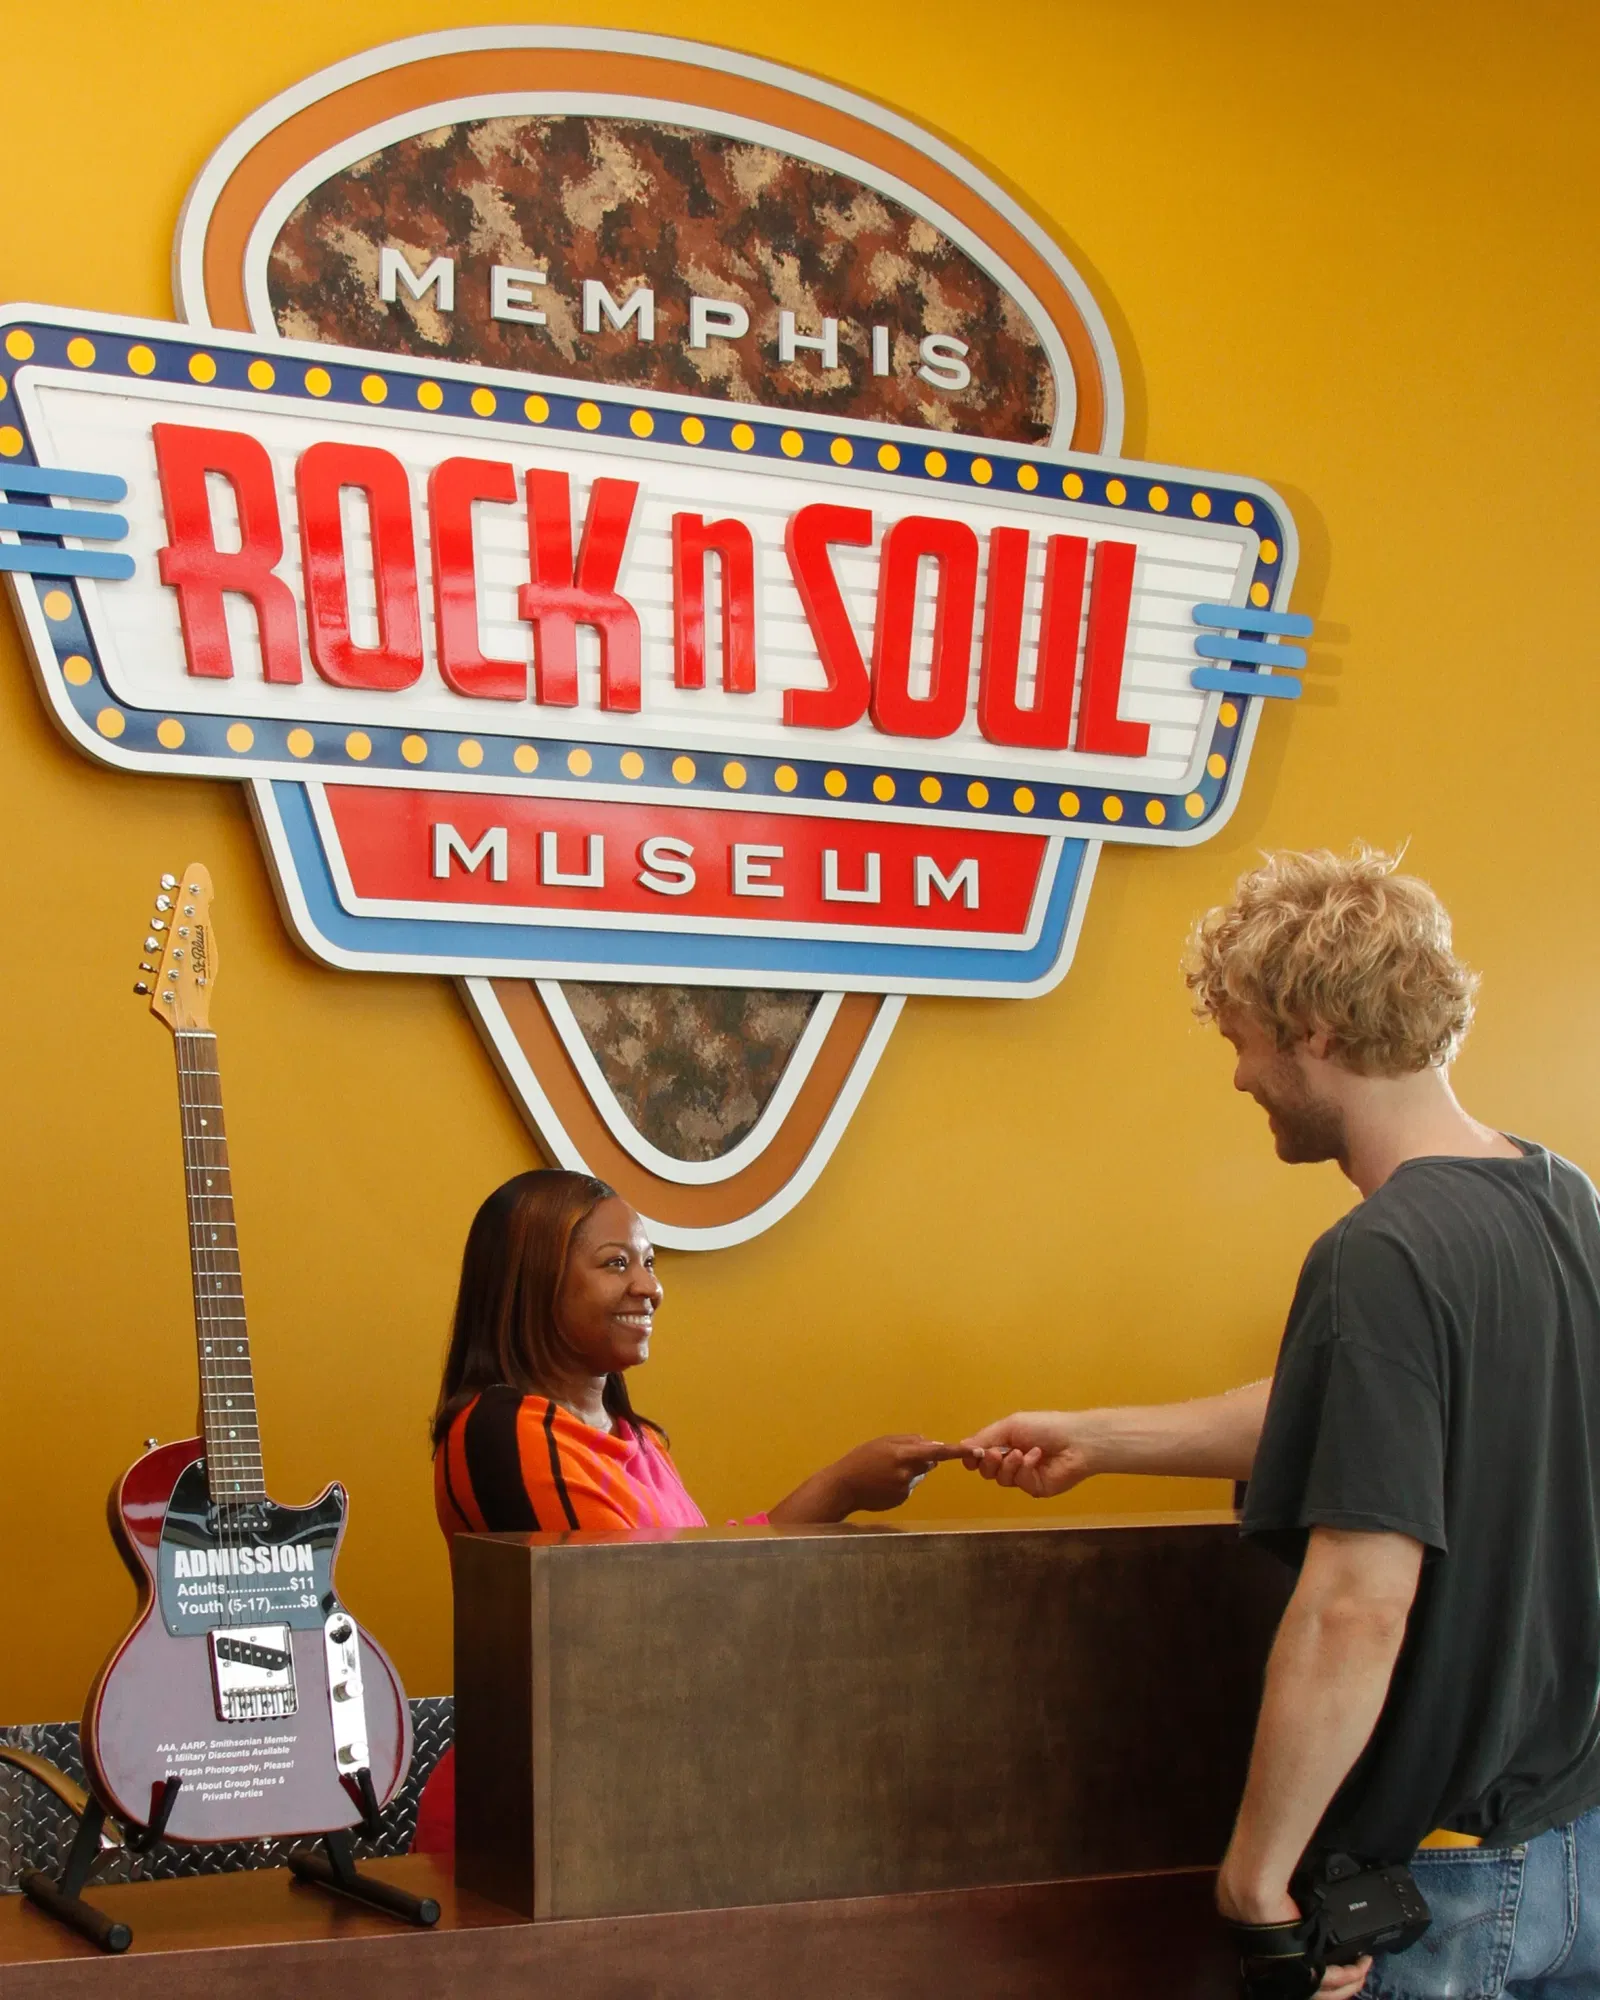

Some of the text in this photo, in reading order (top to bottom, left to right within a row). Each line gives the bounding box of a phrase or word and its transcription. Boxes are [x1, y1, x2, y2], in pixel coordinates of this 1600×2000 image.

[379, 248, 972, 391] MEMPHIS
[151, 422, 1151, 757] ROCK n SOUL
[431, 823, 979, 909] MUSEUM
[191, 924, 206, 960] Blues
[174, 1544, 314, 1578] ADMISSION
[289, 1576, 315, 1591] $11
[178, 1600, 224, 1615] Youth
[228, 1597, 271, 1615] (5-17)
[156, 1735, 297, 1752] AAA, AARP, Smithsonian Member
[166, 1746, 290, 1763] & Military Discounts Available
[179, 1767, 203, 1776] Flash
[205, 1763, 261, 1774] Photography,
[264, 1760, 295, 1770] Please!
[179, 1776, 285, 1792] Ask About Group Rates &
[202, 1789, 263, 1801] Private Parties
